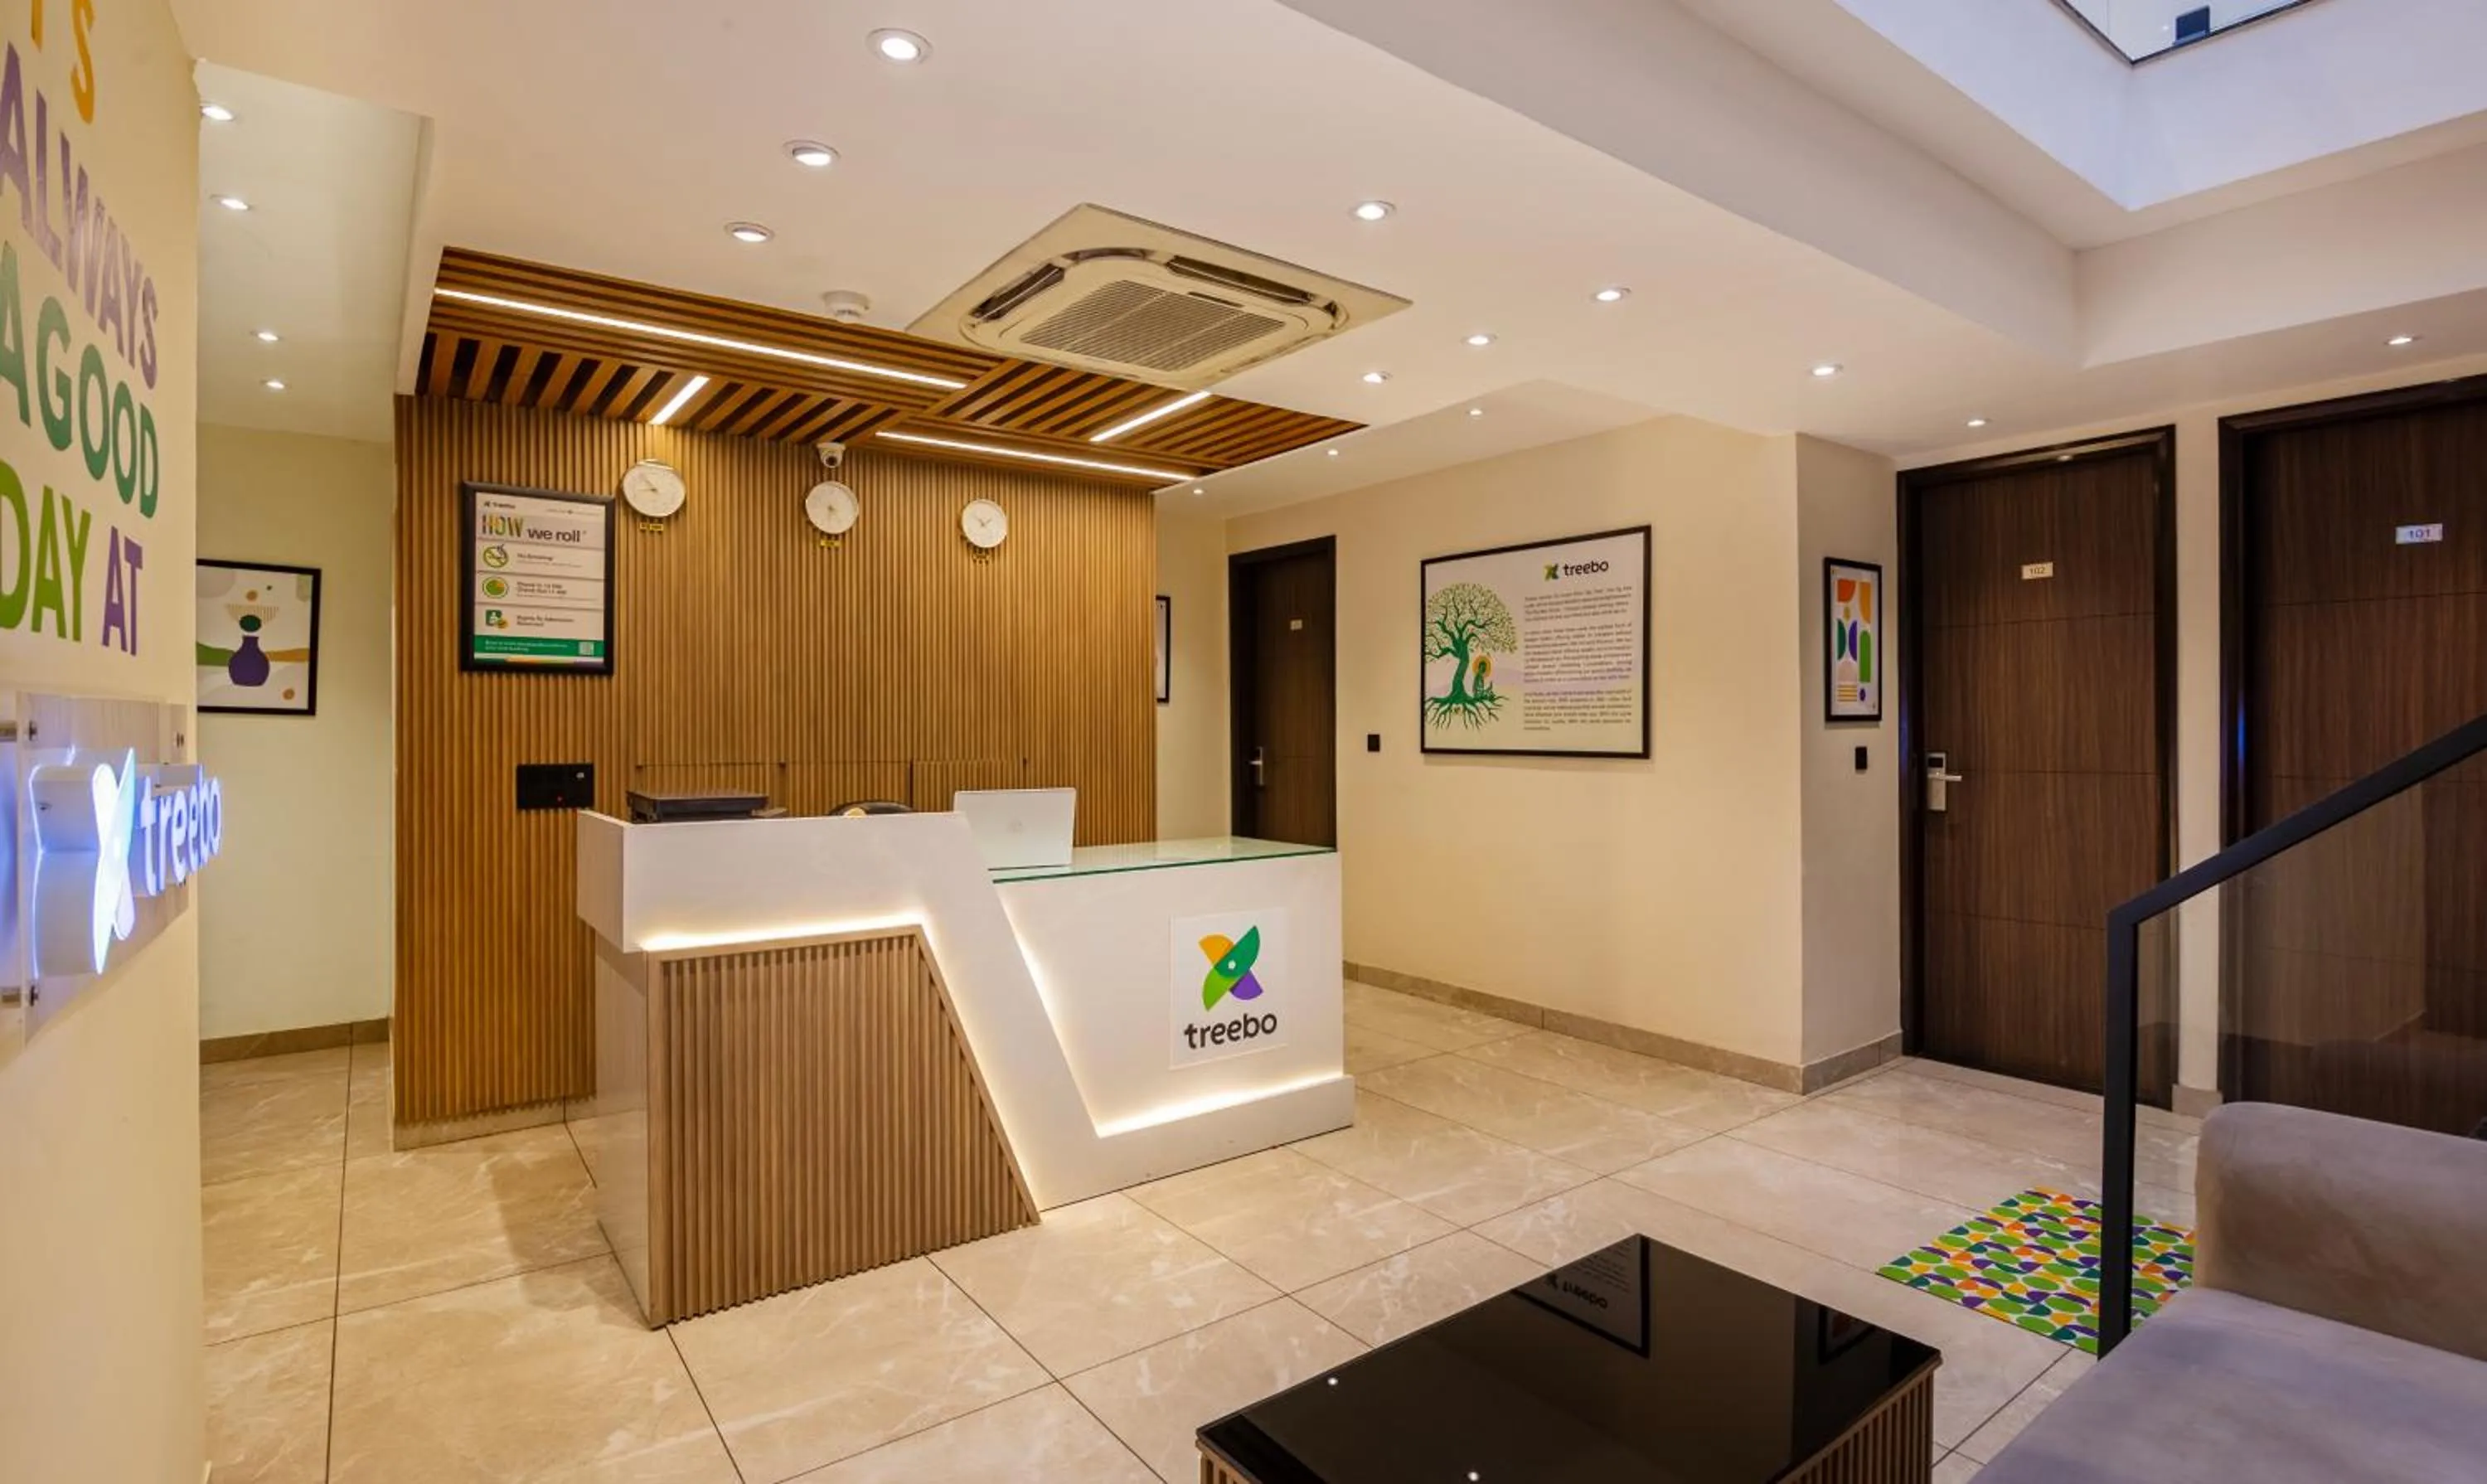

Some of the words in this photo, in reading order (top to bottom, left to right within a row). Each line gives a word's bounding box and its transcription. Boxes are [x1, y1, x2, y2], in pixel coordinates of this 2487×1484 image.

[0, 40, 158, 390] ALWAYS
[482, 514, 524, 538] HOW
[526, 528, 553, 540] we
[556, 530, 580, 542] roll
[2410, 529, 2430, 539] 101
[0, 458, 91, 643] DAY
[102, 525, 143, 657] AT
[1563, 560, 1609, 576] treebo
[139, 764, 223, 896] treebo
[1184, 1013, 1277, 1050] treebo
